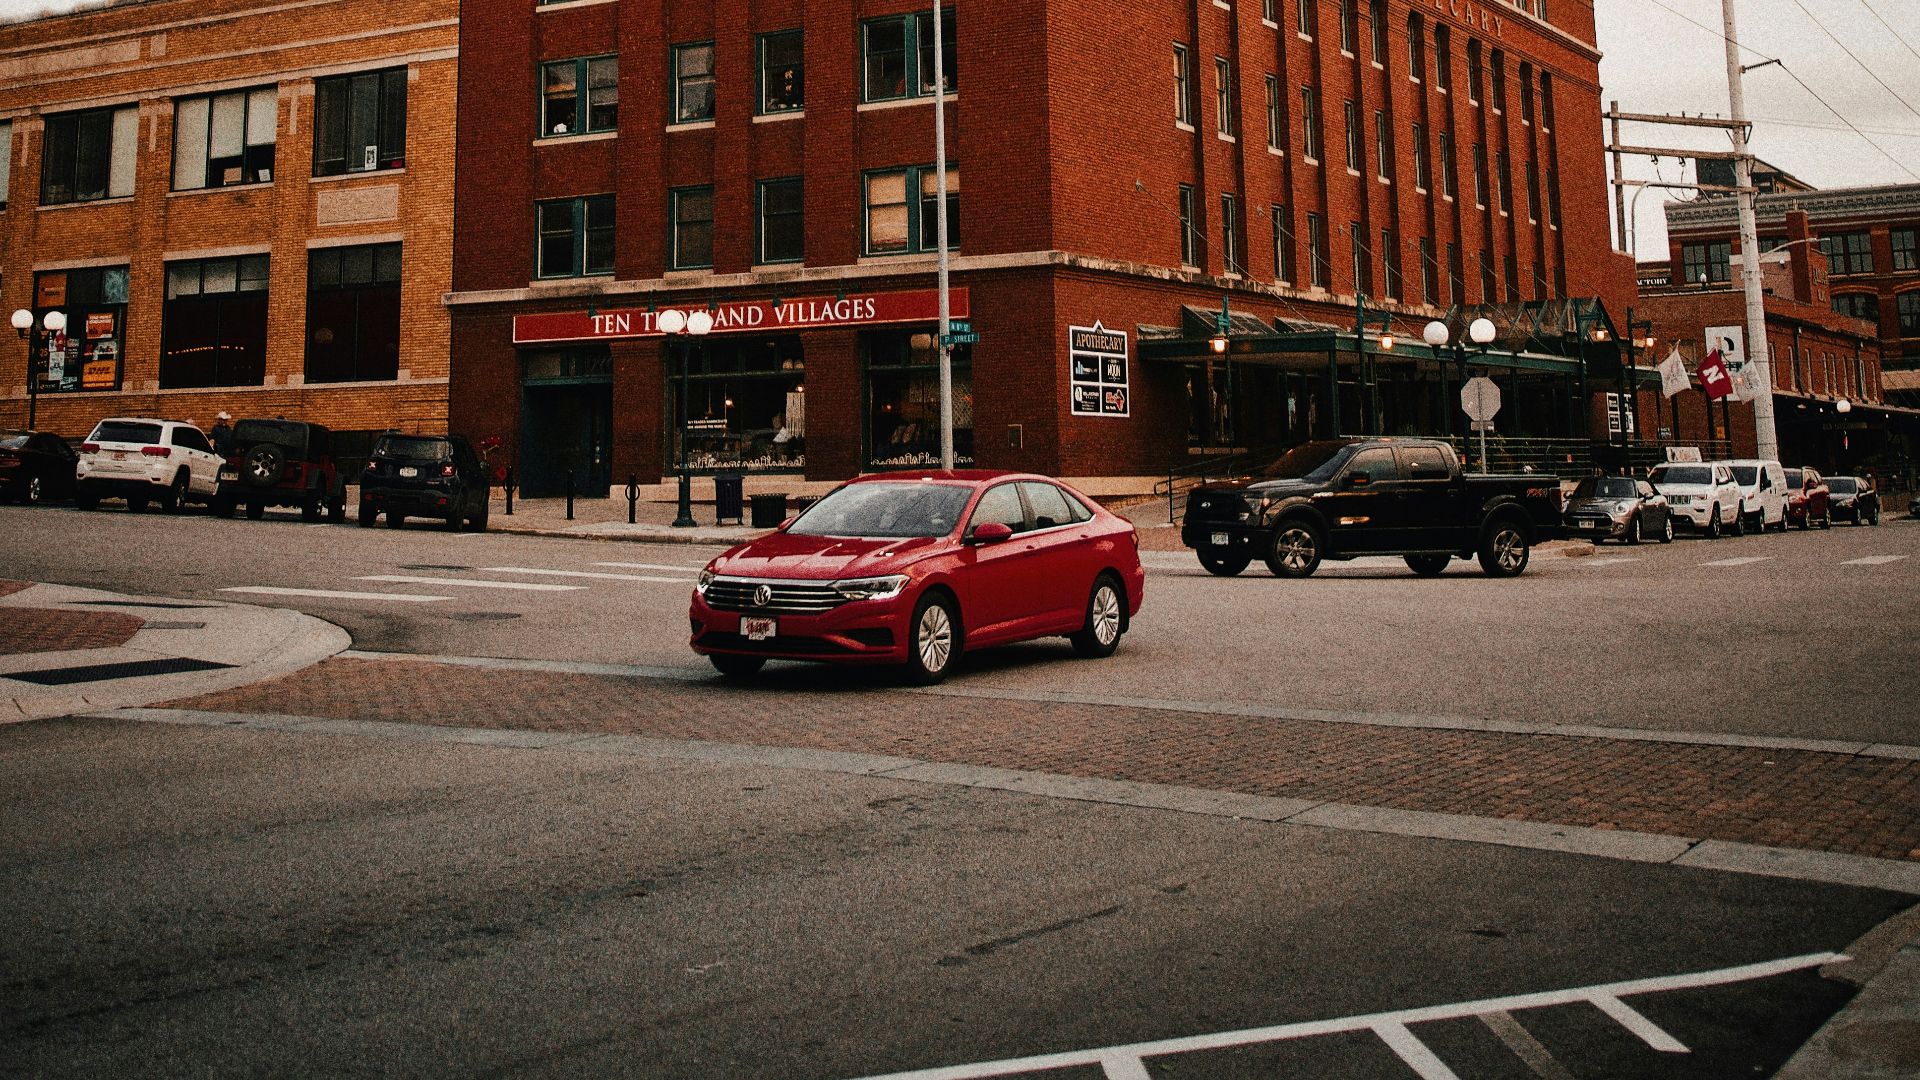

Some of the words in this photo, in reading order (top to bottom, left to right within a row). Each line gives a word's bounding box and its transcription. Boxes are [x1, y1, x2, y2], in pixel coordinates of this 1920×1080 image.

[591, 314, 630, 334] TEN
[774, 298, 875, 323] VILLAGES
[954, 334, 974, 343] STREET
[1076, 333, 1123, 351] APOTHECARY
